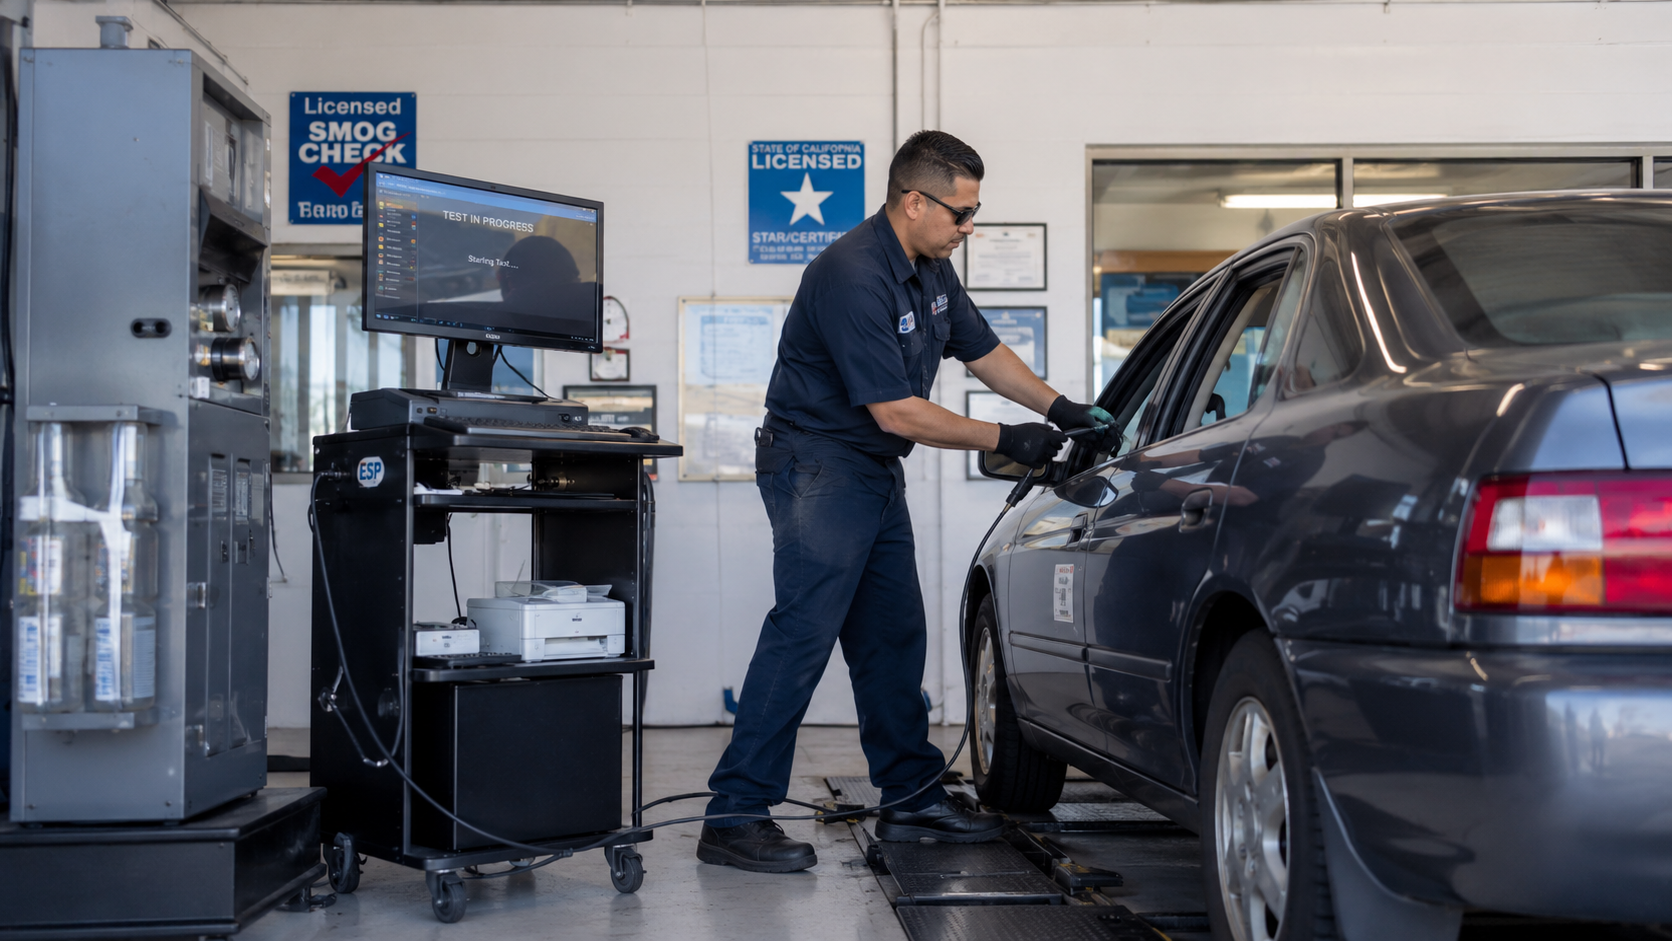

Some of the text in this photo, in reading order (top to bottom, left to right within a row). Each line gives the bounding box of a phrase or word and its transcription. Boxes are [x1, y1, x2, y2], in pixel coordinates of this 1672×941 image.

[305, 97, 401, 115] Licensed
[308, 121, 397, 142] SMOG
[298, 142, 407, 164] CHECK
[752, 143, 783, 154] STATE
[786, 143, 800, 154] OF
[752, 154, 862, 170] LICENSED
[443, 210, 534, 233] TEST IN PROGRESS
[359, 462, 382, 480] ESP
